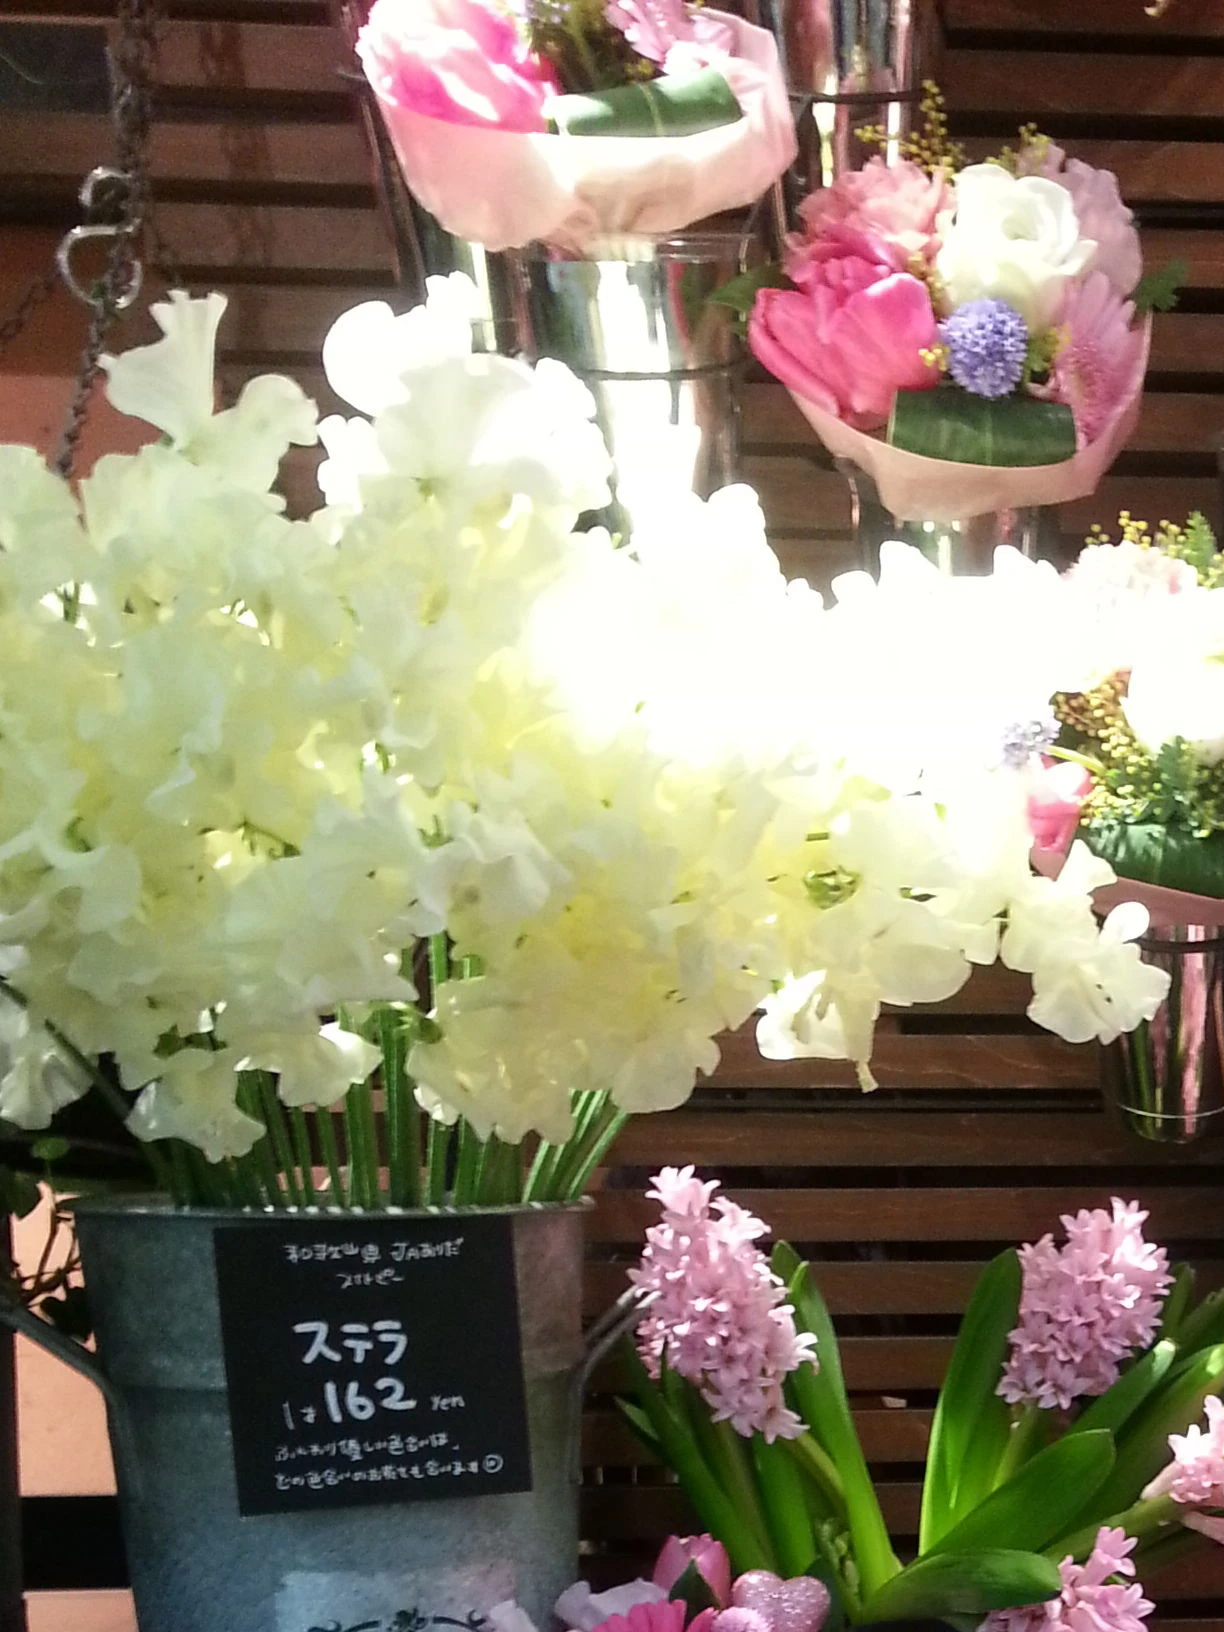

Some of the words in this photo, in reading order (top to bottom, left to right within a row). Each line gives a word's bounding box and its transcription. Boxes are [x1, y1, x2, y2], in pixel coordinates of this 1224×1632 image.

[293, 1319, 409, 1365] ステラ
[324, 1376, 418, 1424] 162
[430, 1394, 466, 1411] yen
